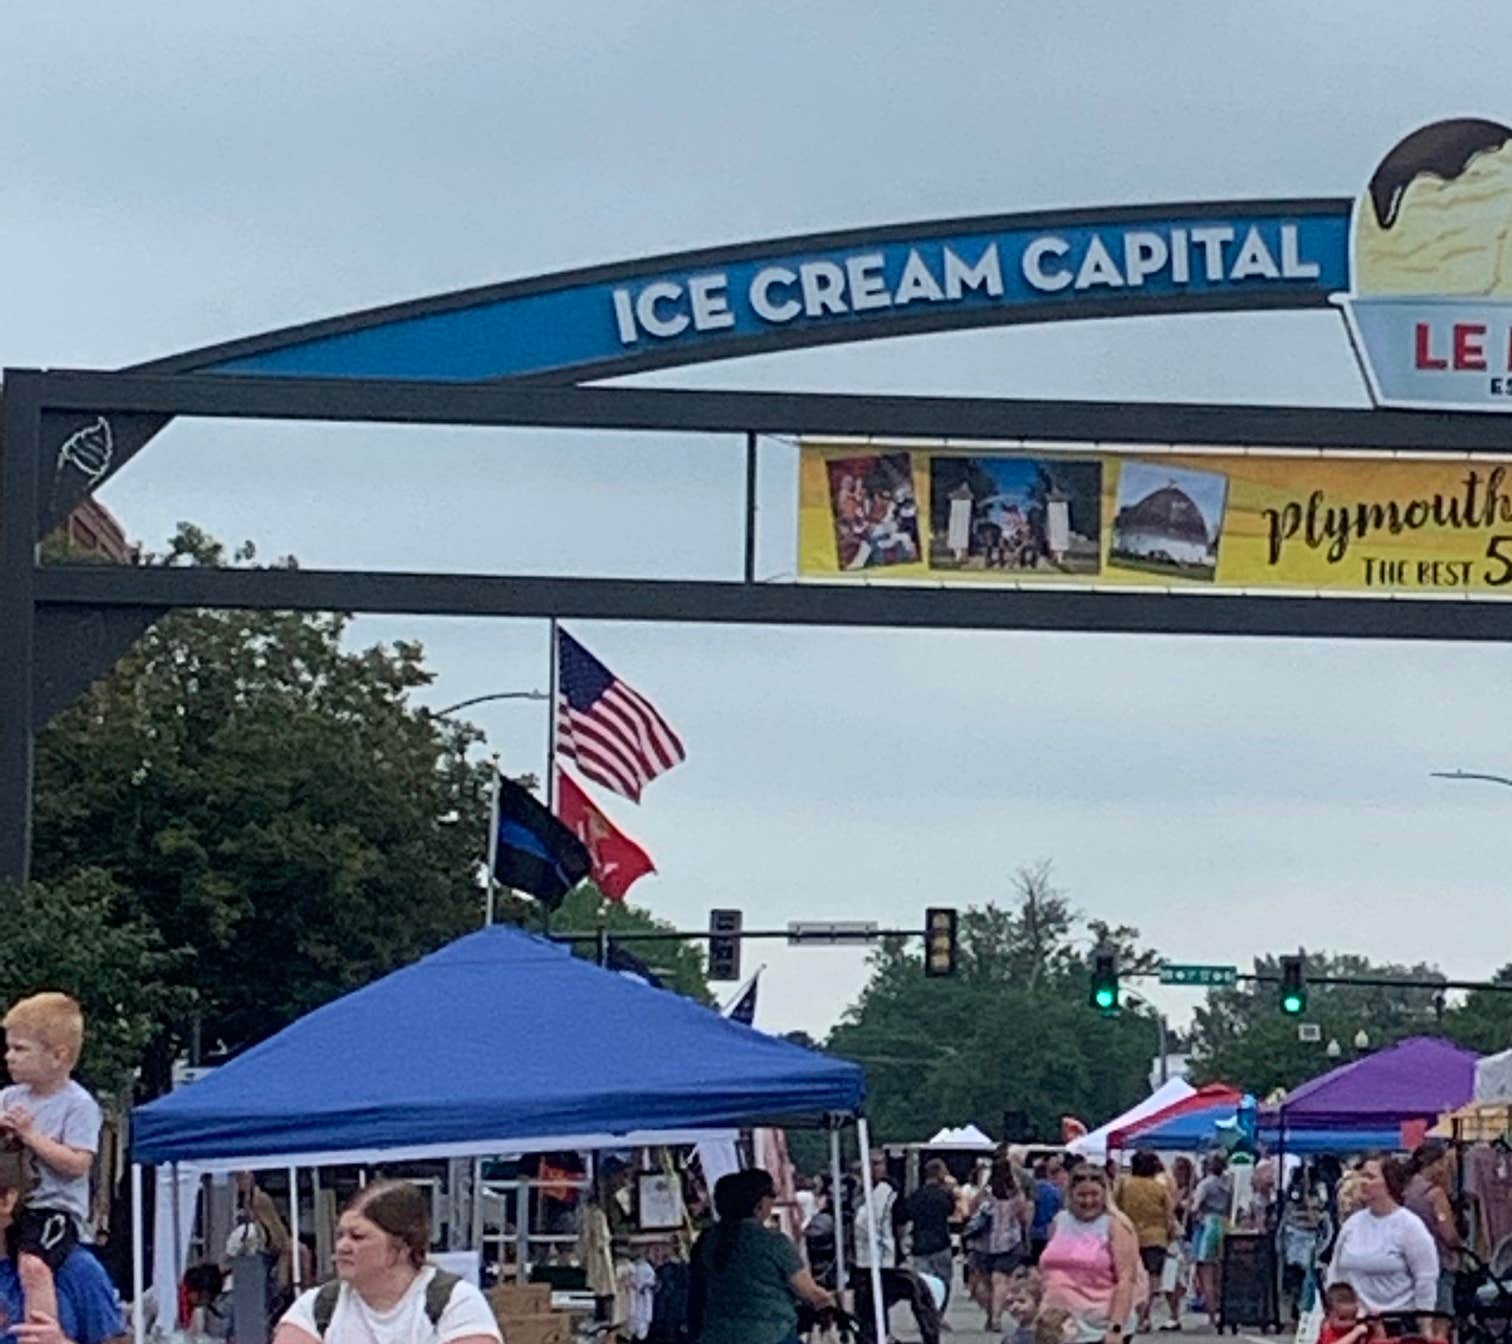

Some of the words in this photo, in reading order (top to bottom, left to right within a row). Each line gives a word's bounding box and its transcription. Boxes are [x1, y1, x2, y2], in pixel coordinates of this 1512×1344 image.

[613, 273, 734, 344] ICE
[749, 242, 1004, 323] CREAM
[1022, 224, 1320, 292] CAPITAL
[1415, 322, 1488, 371] LE
[1362, 557, 1405, 586] THE
[1416, 560, 1473, 586] BEST
